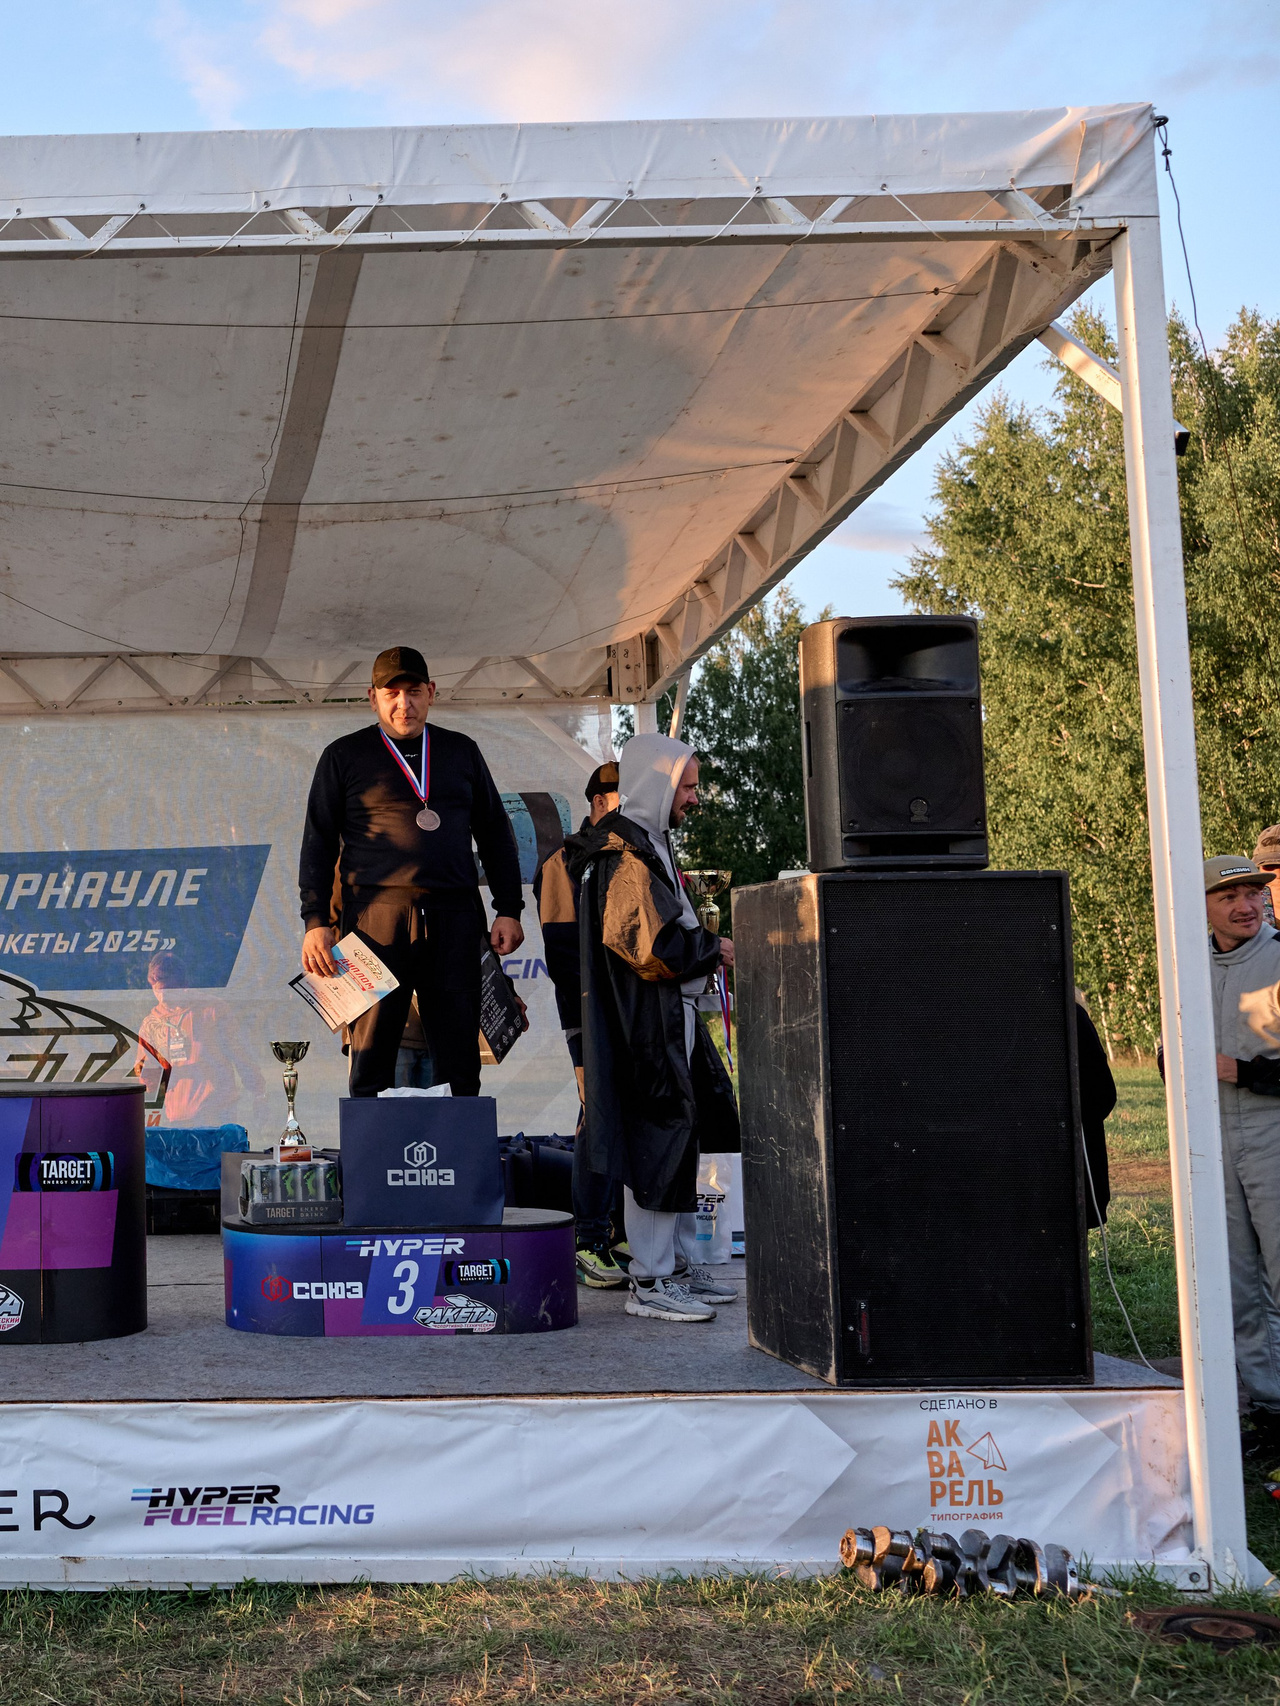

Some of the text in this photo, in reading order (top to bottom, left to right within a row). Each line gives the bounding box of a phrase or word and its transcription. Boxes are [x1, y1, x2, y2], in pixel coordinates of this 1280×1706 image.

[84, 930, 176, 953] 2025»
[339, 958, 374, 990] ДИПЛОМ
[41, 1161, 93, 1178] TARGET
[387, 1169, 455, 1186] СОЮЗ
[696, 1194, 725, 1203] PER
[266, 1208, 296, 1218] TARGET
[359, 1238, 465, 1256] HYPER
[458, 1265, 493, 1277] TARGET
[293, 1282, 363, 1299] СОЮЗ
[387, 1260, 419, 1315] 3
[416, 1307, 496, 1324] РАКЕТА
[920, 1399, 998, 1412] СДЕЛАНО В
[926, 1420, 964, 1447] АК
[926, 1450, 966, 1478] ВА
[148, 1485, 281, 1507] HYPER
[930, 1480, 1004, 1507] РЕЛЬ
[930, 1512, 1003, 1521] ТИПОГРАФИЯ
